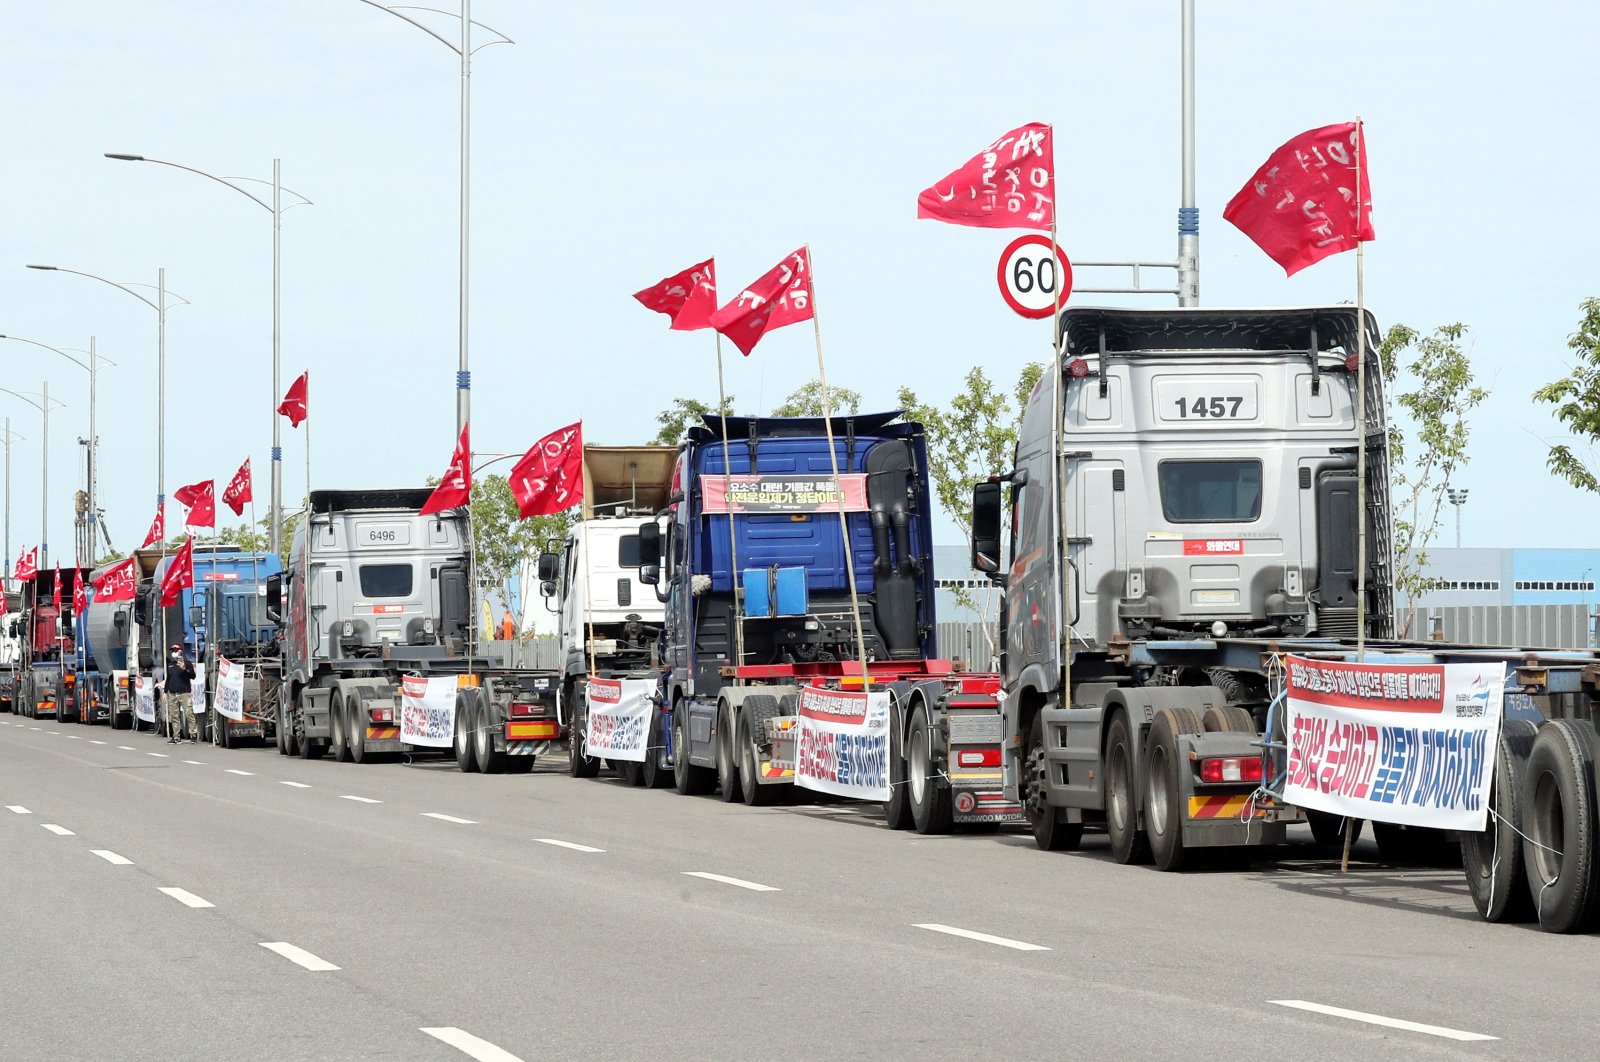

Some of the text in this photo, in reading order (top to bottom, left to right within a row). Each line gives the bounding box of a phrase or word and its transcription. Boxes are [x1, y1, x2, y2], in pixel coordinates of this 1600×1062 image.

[1013, 257, 1057, 294] 60
[1175, 397, 1243, 418] 1457
[730, 482, 758, 492] 요소수
[761, 482, 783, 493] 대란!
[785, 482, 814, 492] 기름값
[724, 492, 793, 503] 안전운임제가
[369, 530, 396, 541] 6496
[1206, 540, 1240, 551] 화물연대
[1355, 670, 1383, 697] 함성으로
[1382, 672, 1408, 699] 일몰제를
[1409, 673, 1441, 699] 폐지하자!!
[229, 727, 264, 735] HYUNDA
[1288, 713, 1488, 811] 총파업 승리하고 일몰제 폐지하자!!
[954, 814, 993, 822] DONGWOO
